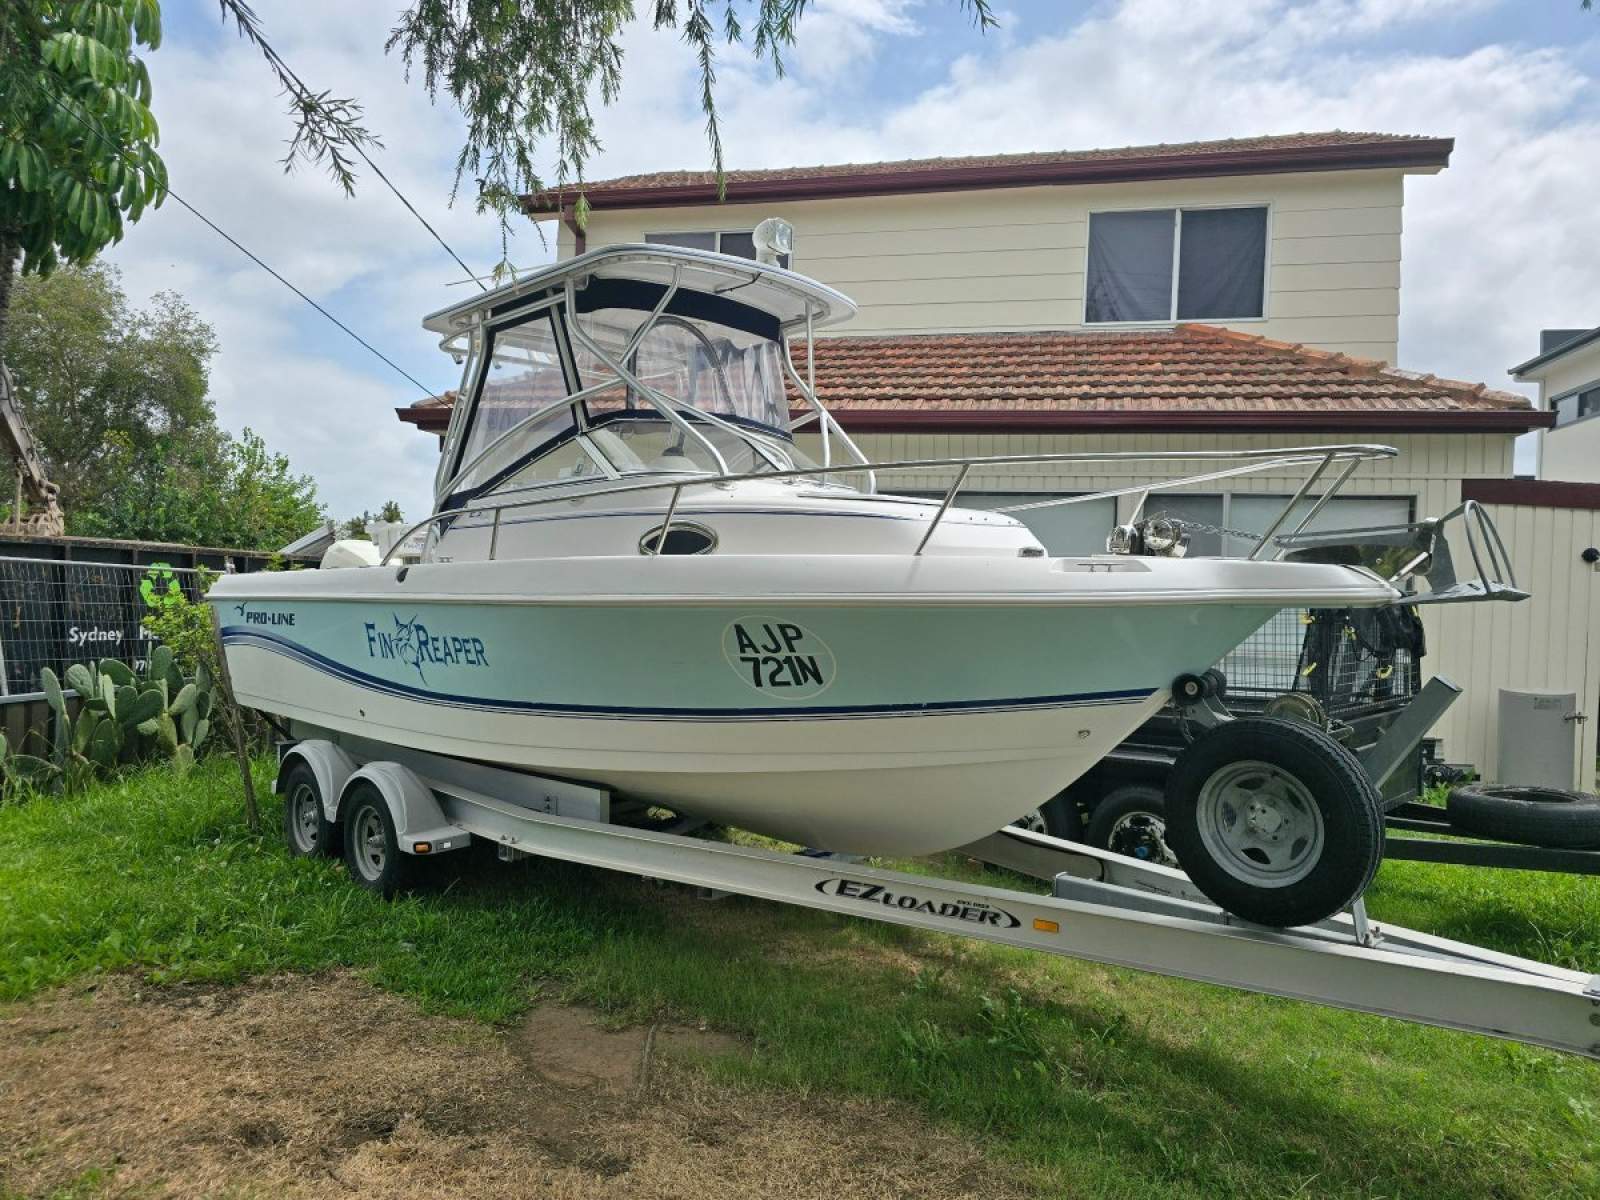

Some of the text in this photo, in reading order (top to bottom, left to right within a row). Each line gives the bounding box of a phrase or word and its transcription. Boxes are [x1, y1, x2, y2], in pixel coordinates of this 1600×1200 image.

[69, 626, 122, 646] Sydney
[364, 622, 490, 666] FIN REAPER
[734, 623, 803, 654] AJP
[740, 655, 824, 688] 721N
